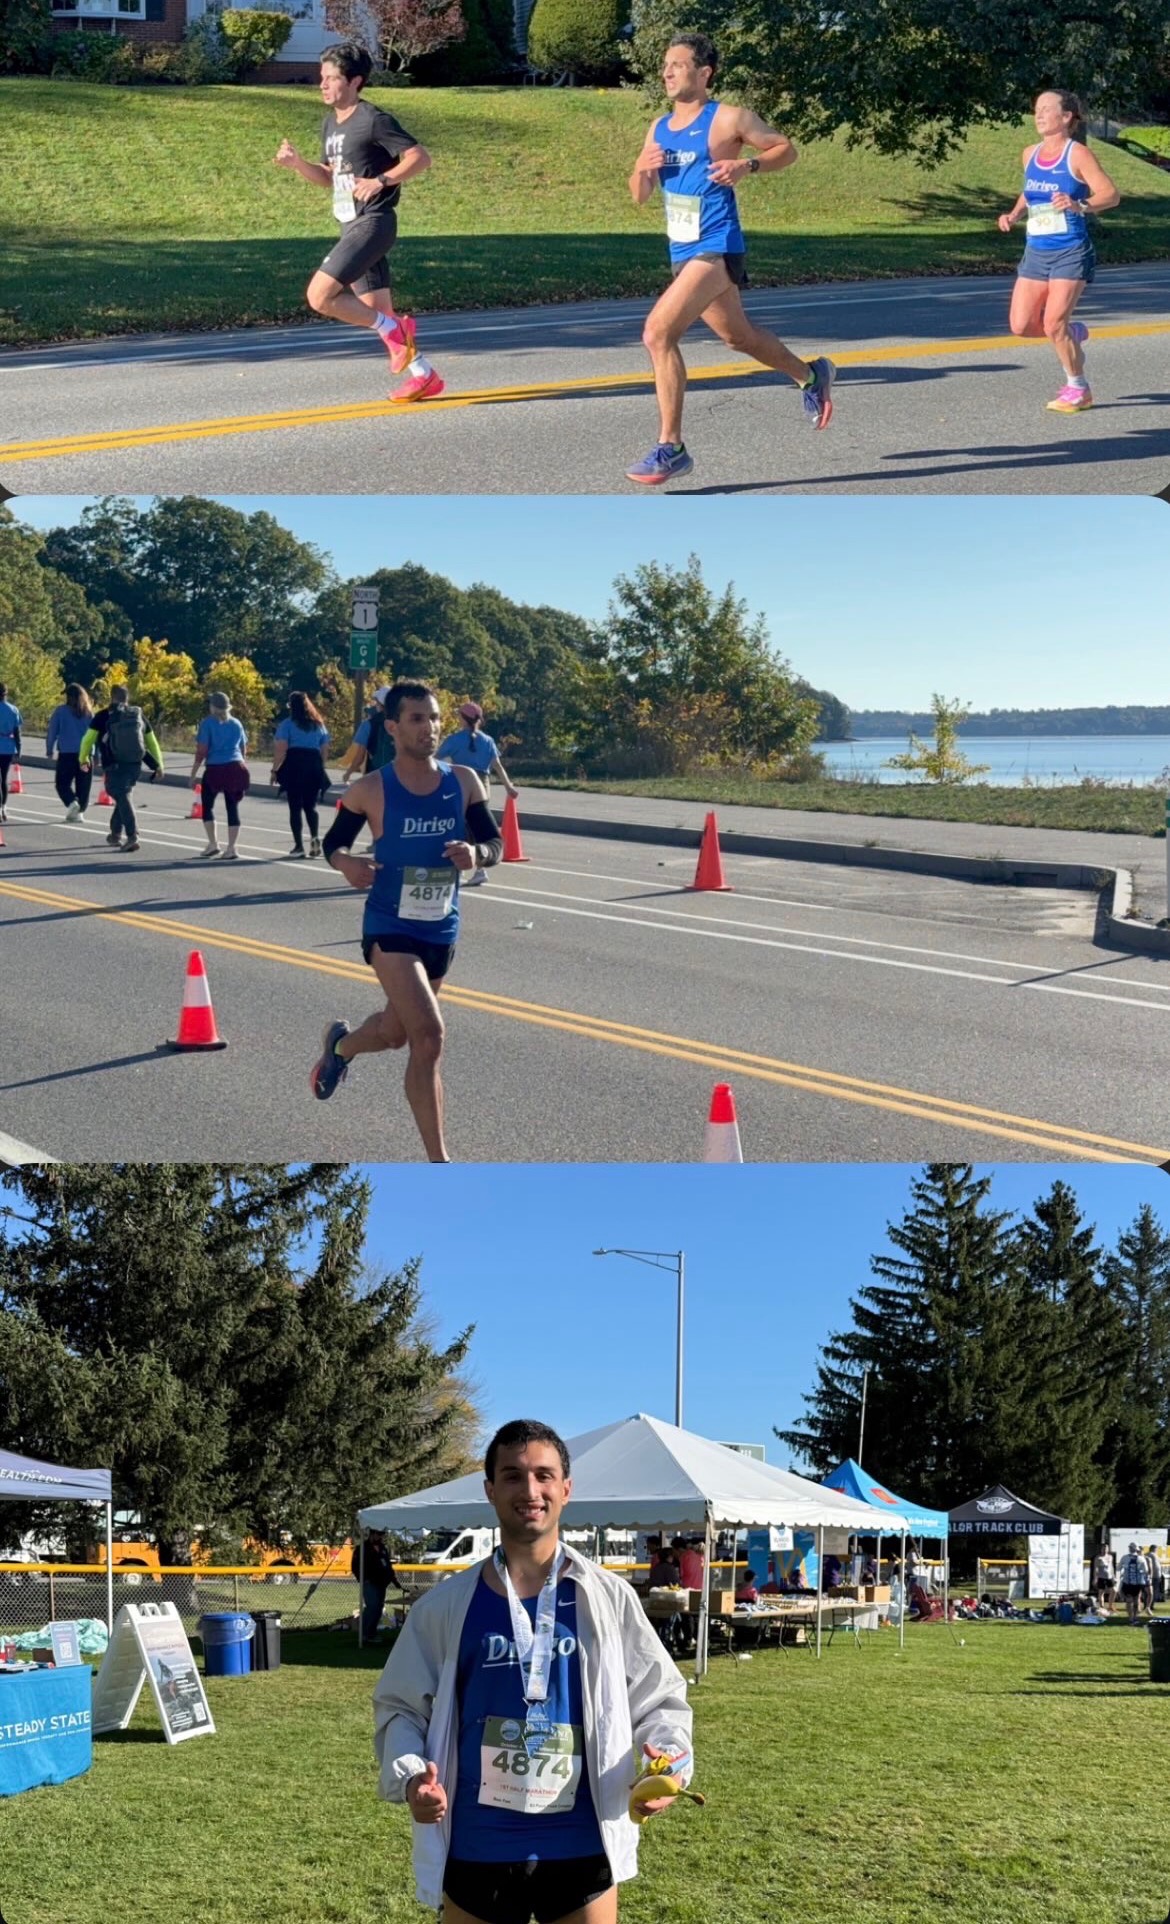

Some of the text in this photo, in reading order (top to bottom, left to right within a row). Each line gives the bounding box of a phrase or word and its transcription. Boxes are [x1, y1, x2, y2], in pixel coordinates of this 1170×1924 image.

[664, 149, 696, 167] irigo
[1026, 180, 1059, 192] Dirigo
[363, 609, 368, 624] 1
[359, 645, 368, 656] G
[400, 817, 455, 837] Dirigo
[409, 887, 451, 900] 4874
[975, 1522, 1013, 1533] TRACK
[1015, 1523, 1044, 1533] CLUB
[0, 1710, 91, 1740] STEADY STATE
[492, 1750, 570, 1779] 4874
